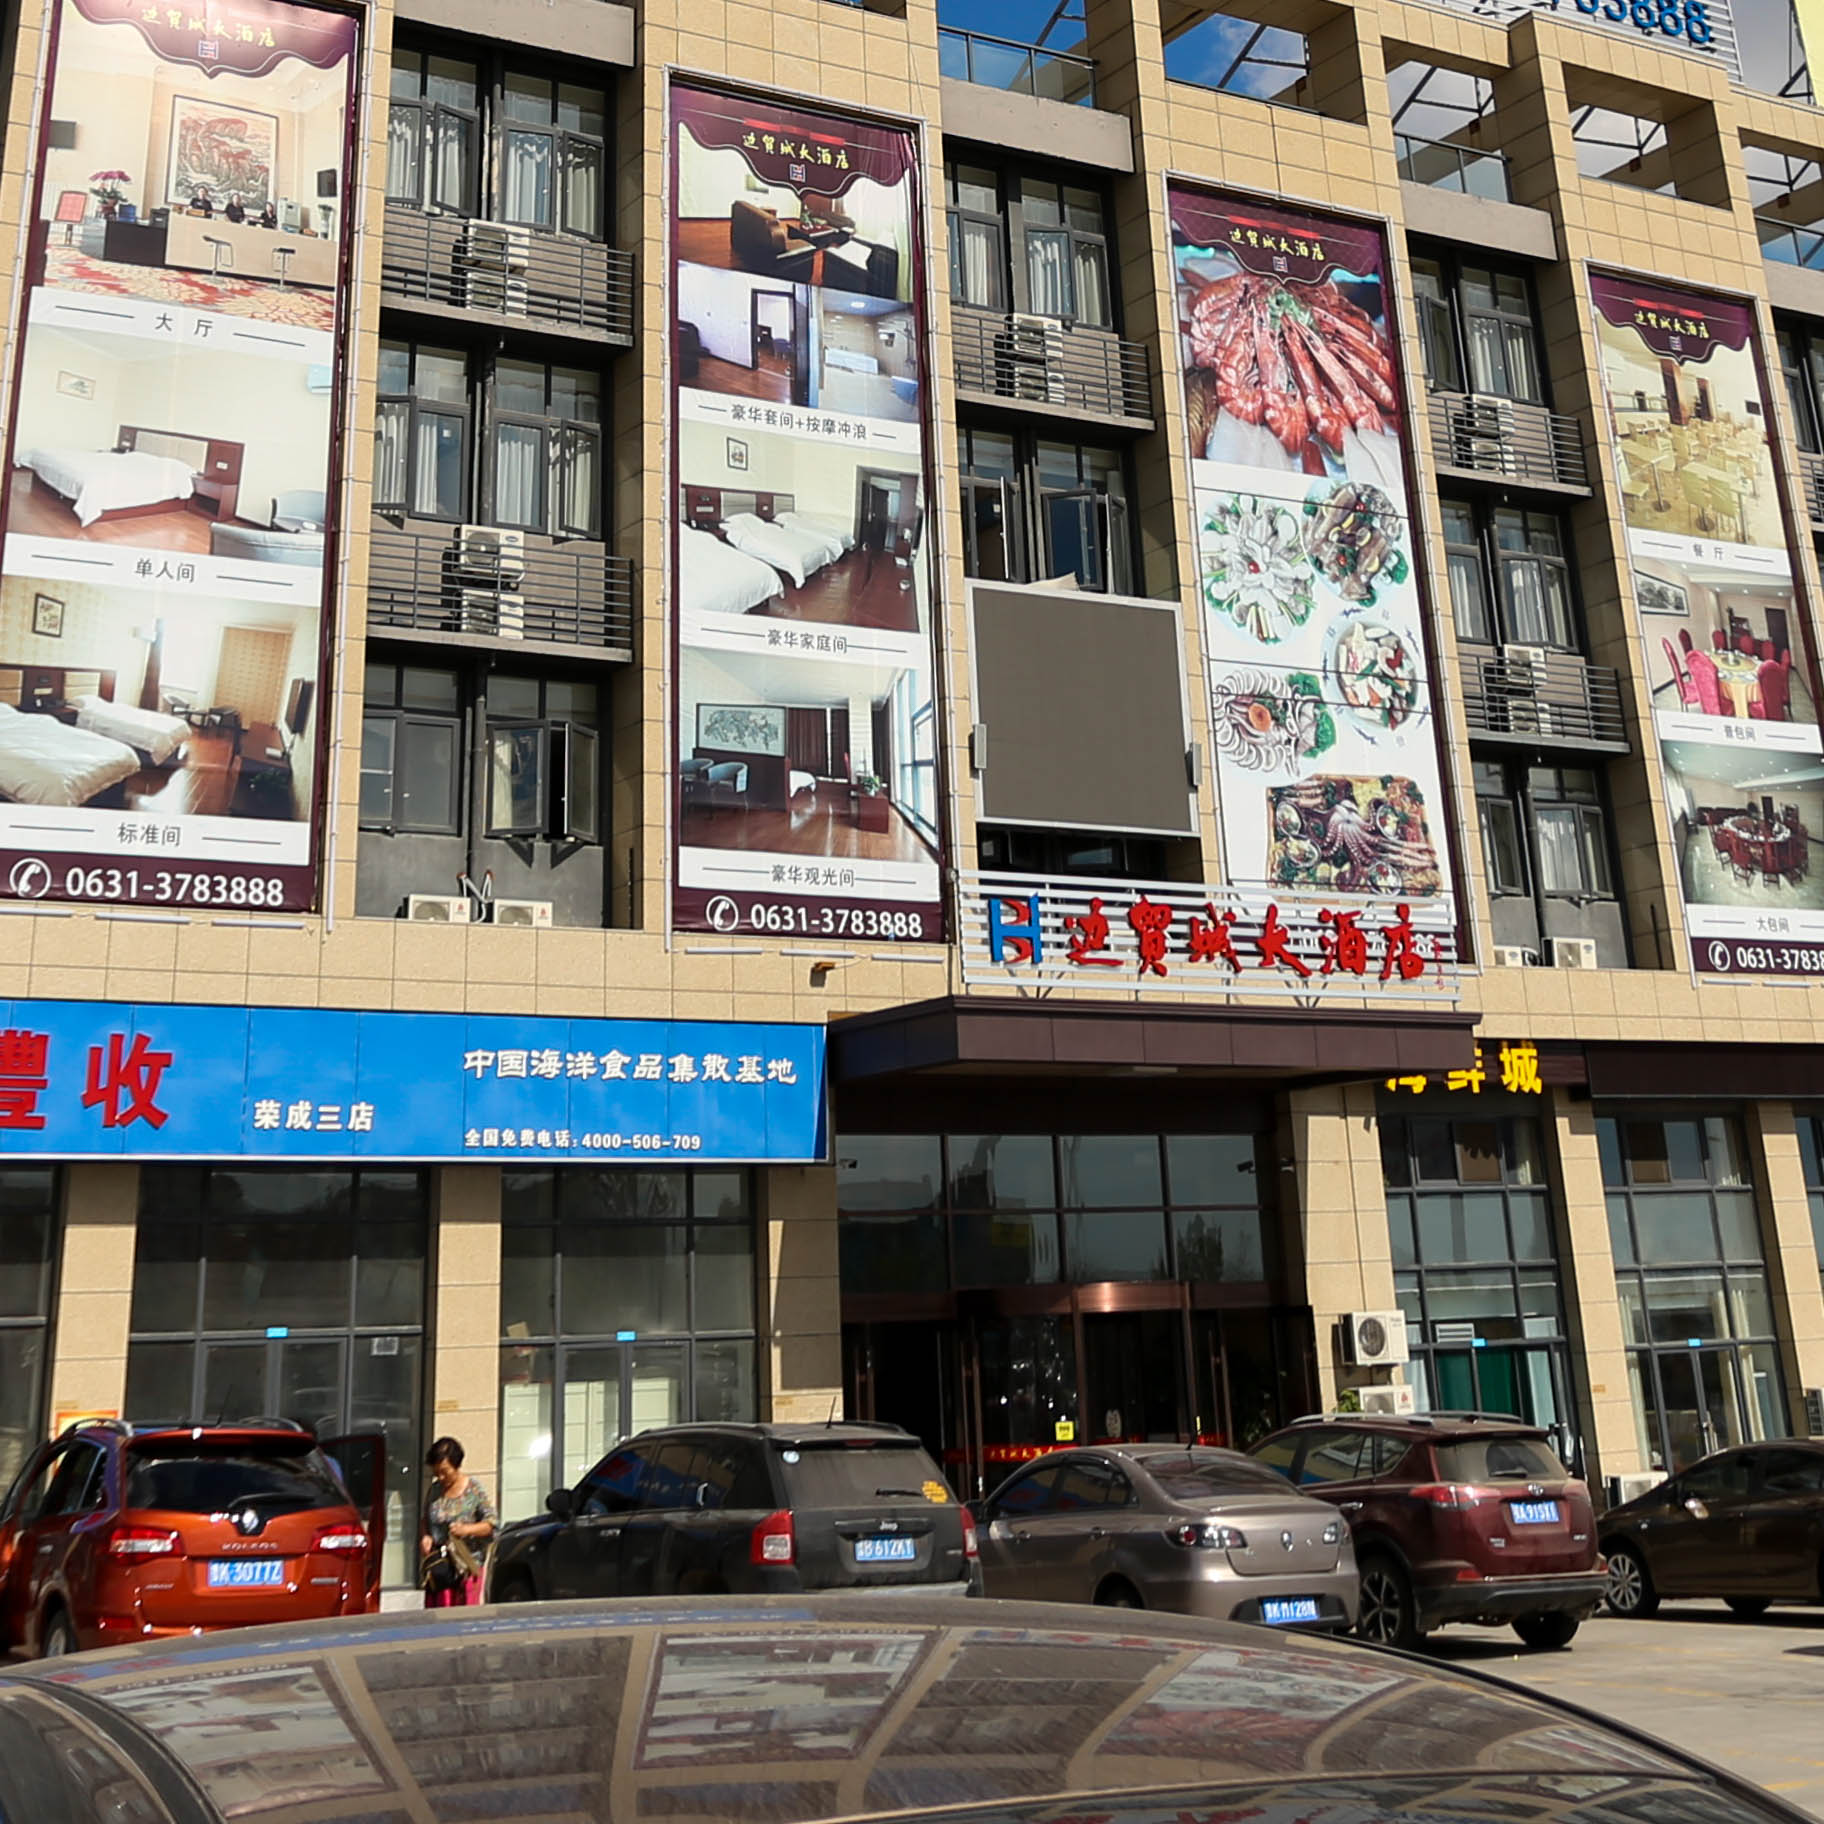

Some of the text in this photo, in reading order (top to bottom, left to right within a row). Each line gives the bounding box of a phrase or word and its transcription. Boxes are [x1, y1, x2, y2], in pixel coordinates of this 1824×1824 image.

[155, 312, 213, 339] 大厅
[135, 557, 196, 584] 单人间
[767, 628, 848, 654] 豪华家庭间
[117, 822, 182, 847] 标准间
[65, 867, 284, 906] 0631-3783888
[770, 864, 855, 887] 豪华观光间
[750, 903, 923, 938] 0631-3783888
[462, 1049, 798, 1085] 中国海洋食品集散基地
[253, 1099, 376, 1133] 荣成三店
